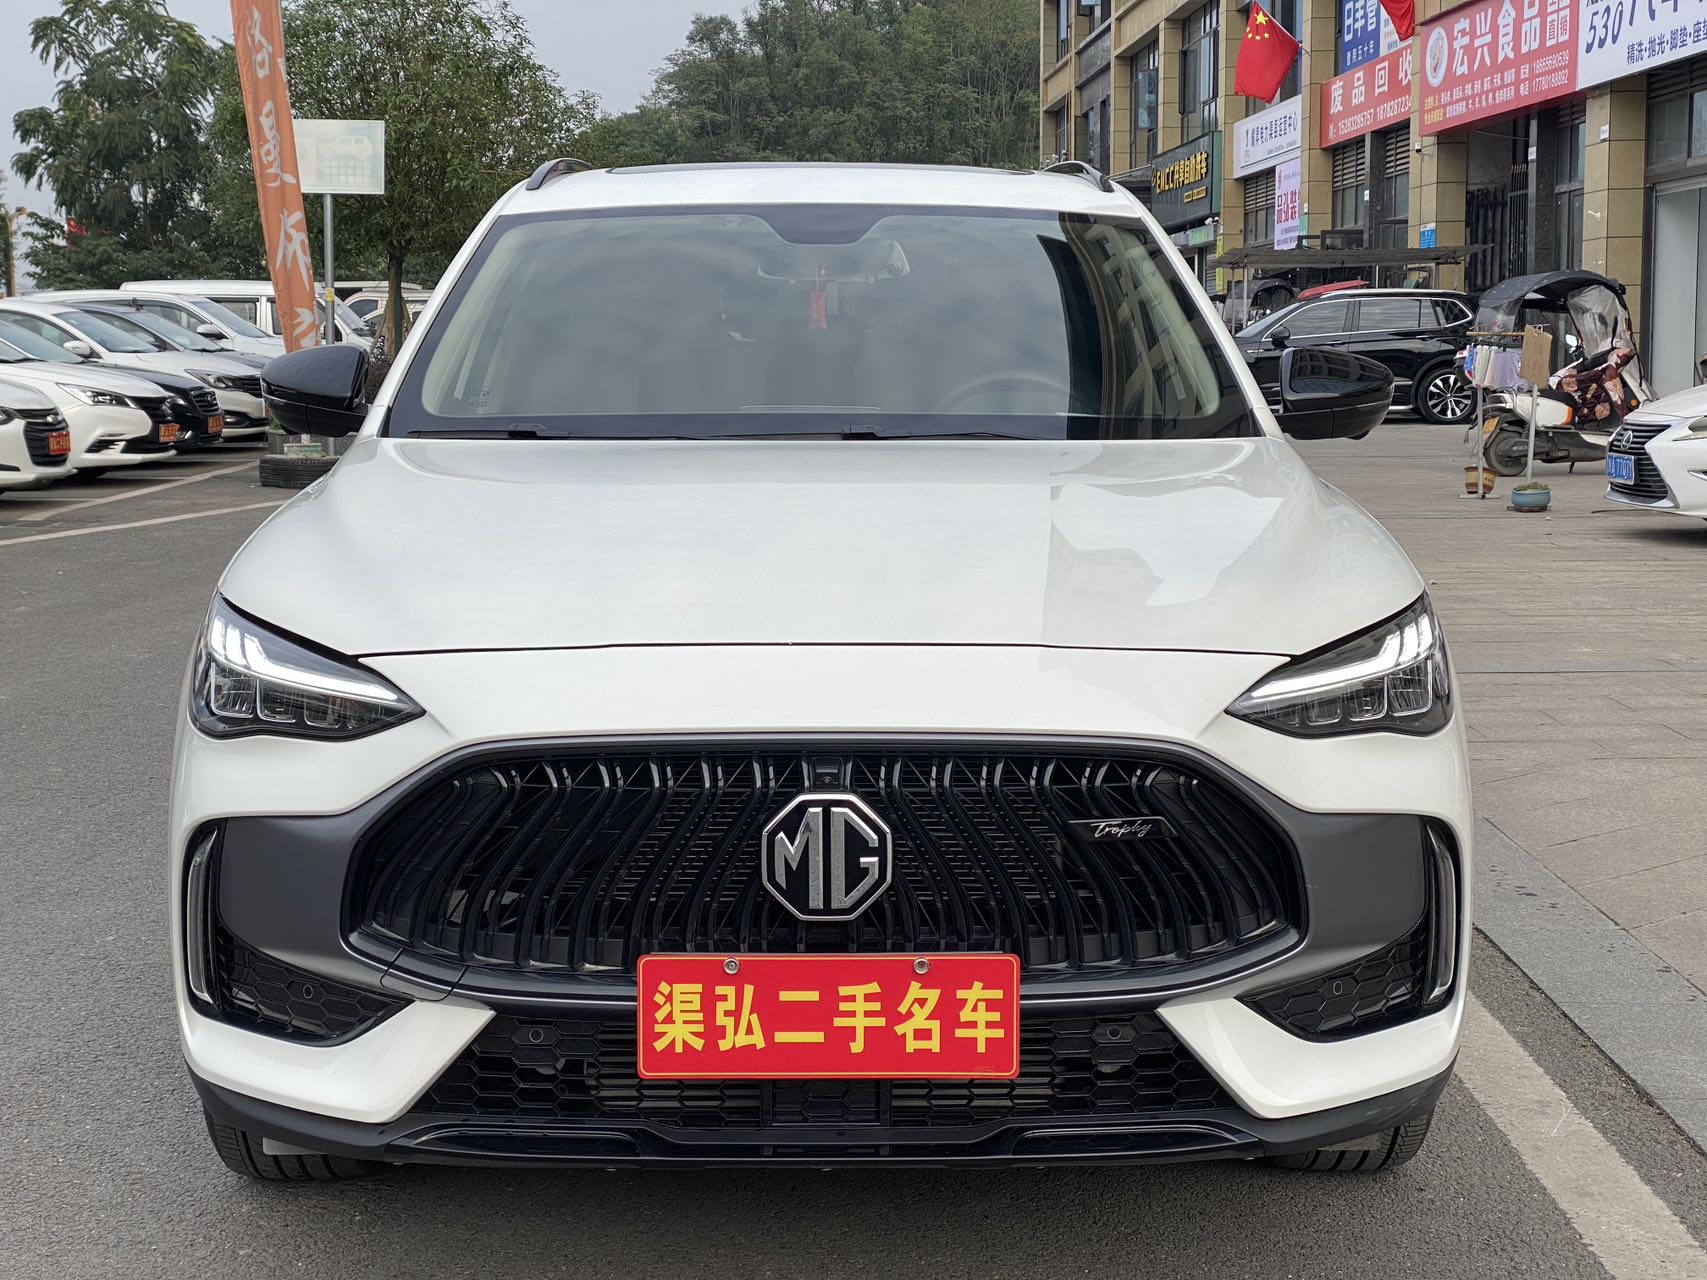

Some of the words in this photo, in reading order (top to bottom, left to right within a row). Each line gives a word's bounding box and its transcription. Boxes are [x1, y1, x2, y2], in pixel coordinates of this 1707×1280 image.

[1453, 0, 1541, 76] 宏兴食品
[1547, 11, 1569, 43] 直销
[1330, 49, 1412, 115] 废品回收
[1377, 94, 1412, 121] 187828723
[775, 806, 879, 910] MG
[1090, 819, 1154, 838] Trophy
[652, 981, 1006, 1054] 渠弘二手名车
